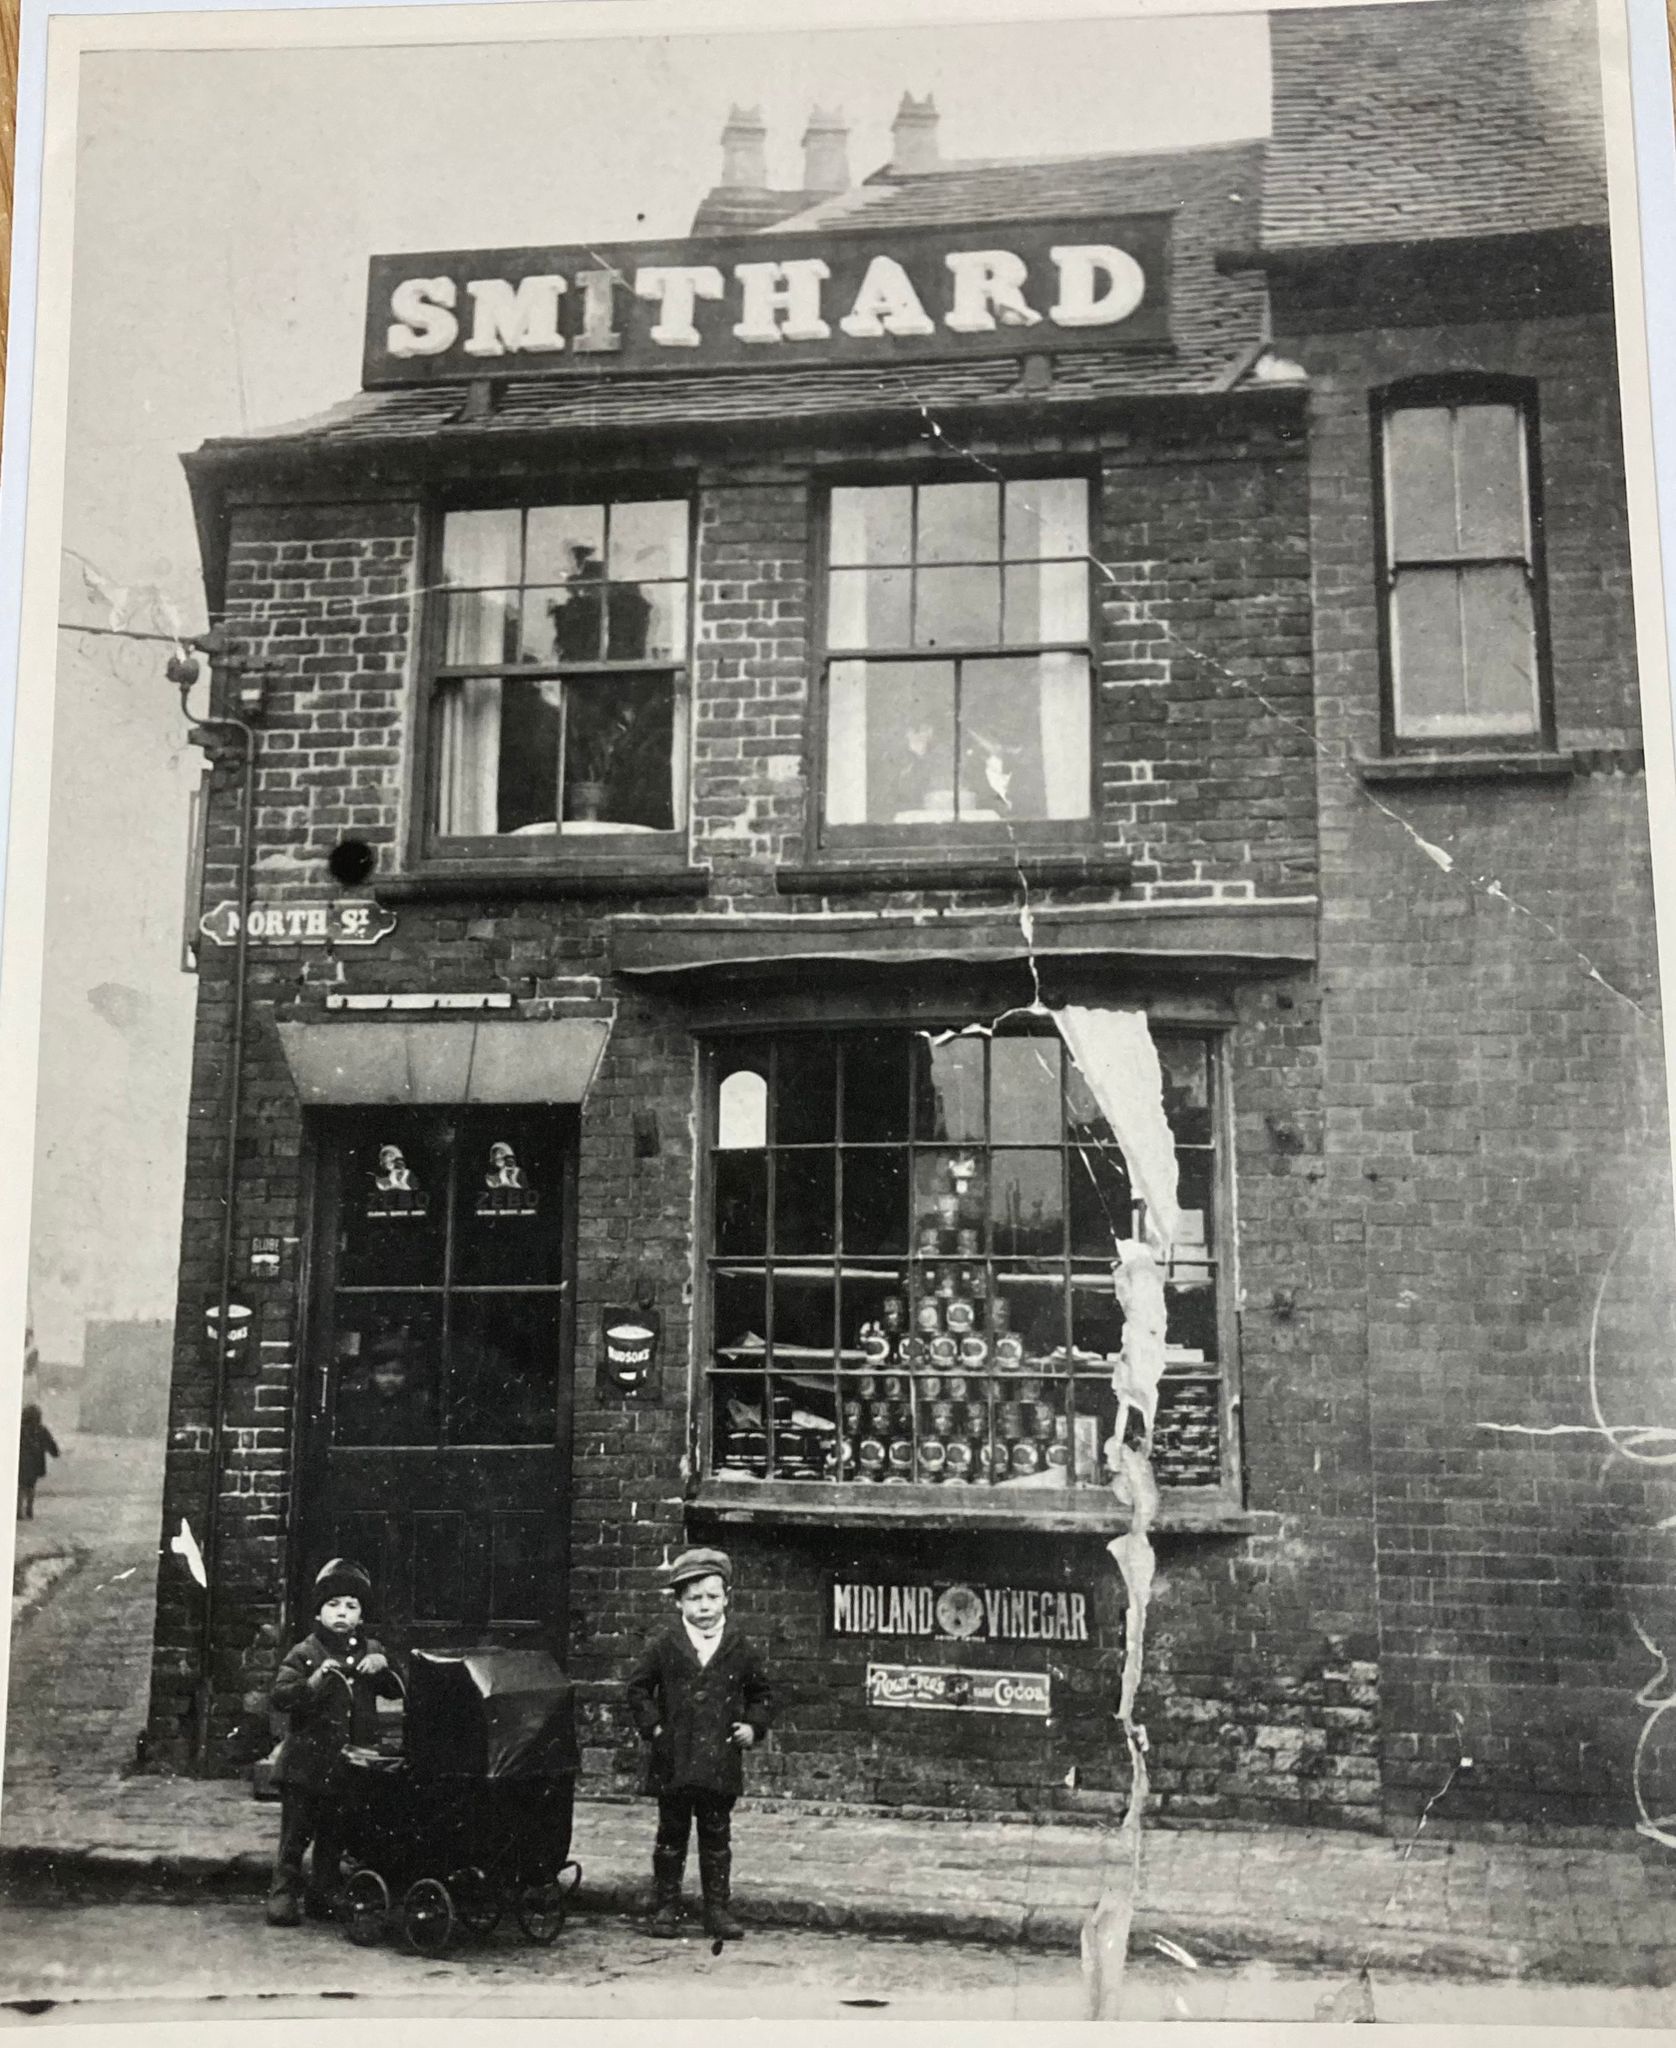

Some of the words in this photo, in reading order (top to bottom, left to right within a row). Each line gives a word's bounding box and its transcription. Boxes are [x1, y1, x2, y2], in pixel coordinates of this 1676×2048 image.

[387, 243, 1147, 357] SMITHARD
[226, 910, 327, 937] NORTH
[834, 1584, 933, 1634] MIDLAND
[985, 1589, 1088, 1641] VINEGAR
